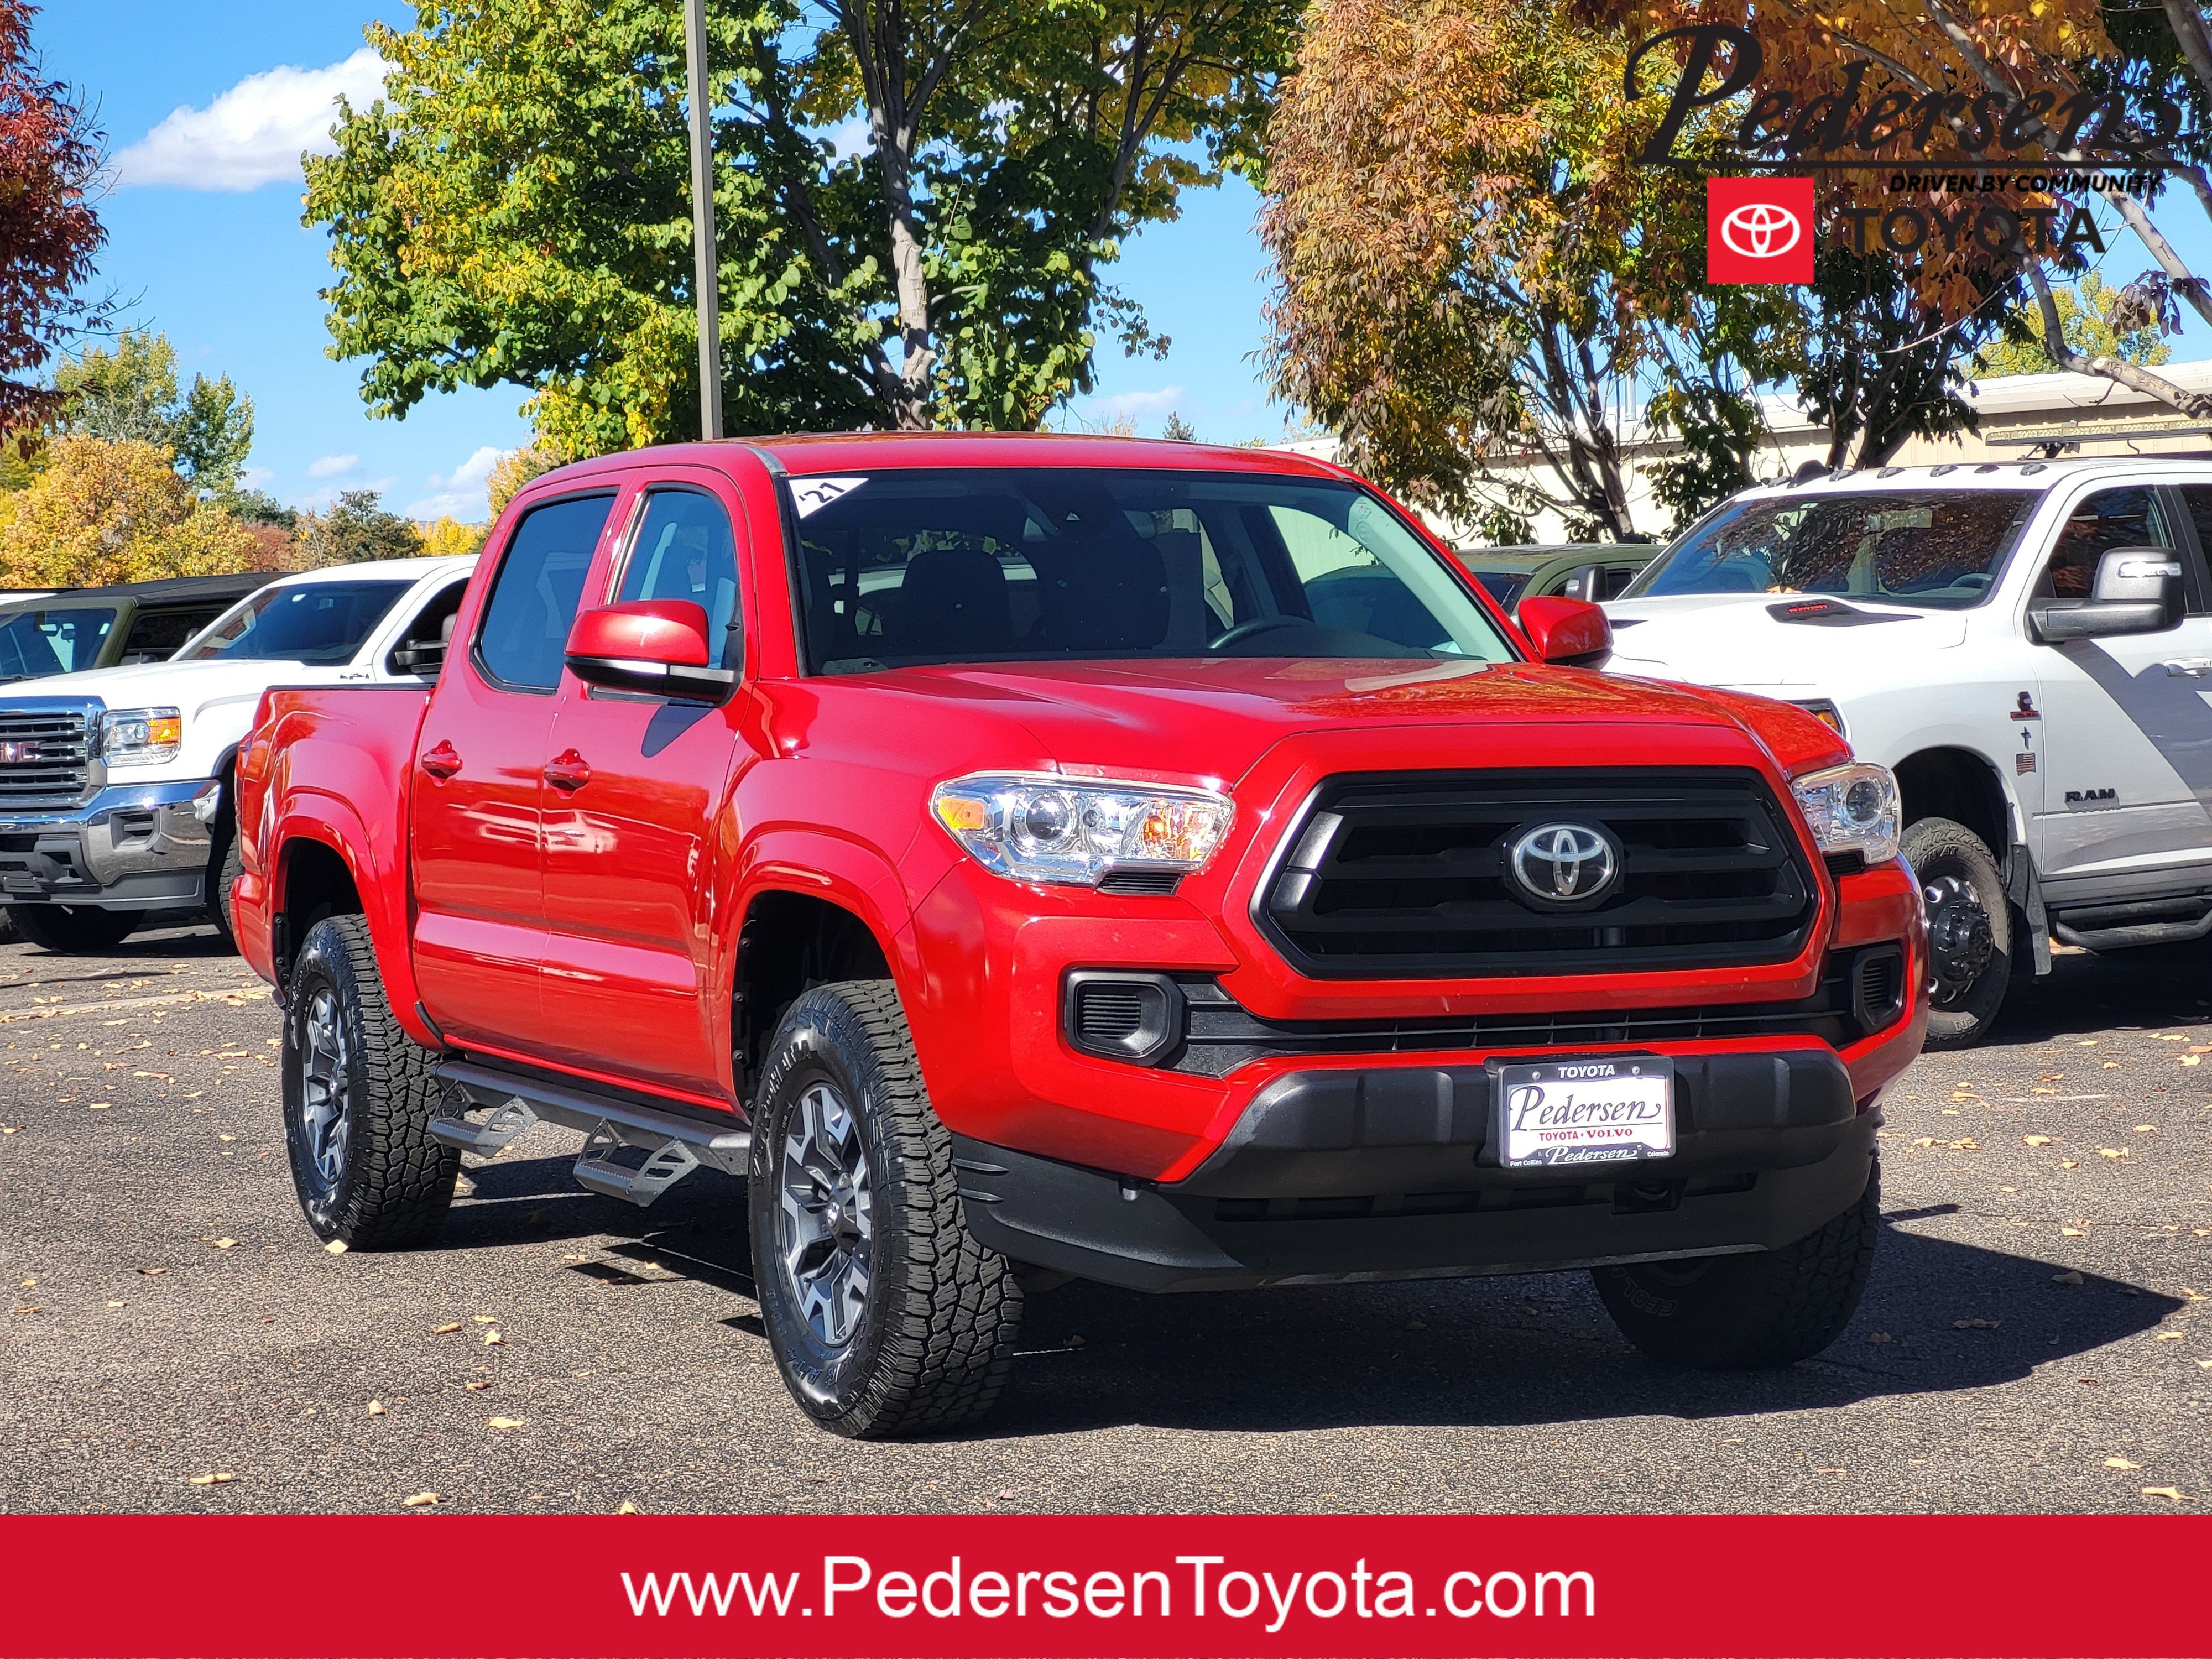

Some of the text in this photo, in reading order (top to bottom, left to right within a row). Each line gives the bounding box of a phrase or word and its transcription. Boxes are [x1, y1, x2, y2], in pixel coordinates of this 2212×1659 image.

[2065, 788, 2116, 802] RAM
[1557, 1064, 1615, 1079] TOYOTA
[1509, 1086, 1661, 1131] Pedersen
[1539, 1129, 1633, 1141] TOYOTA VOLVO
[1545, 1145, 1637, 1165] Pedersen
